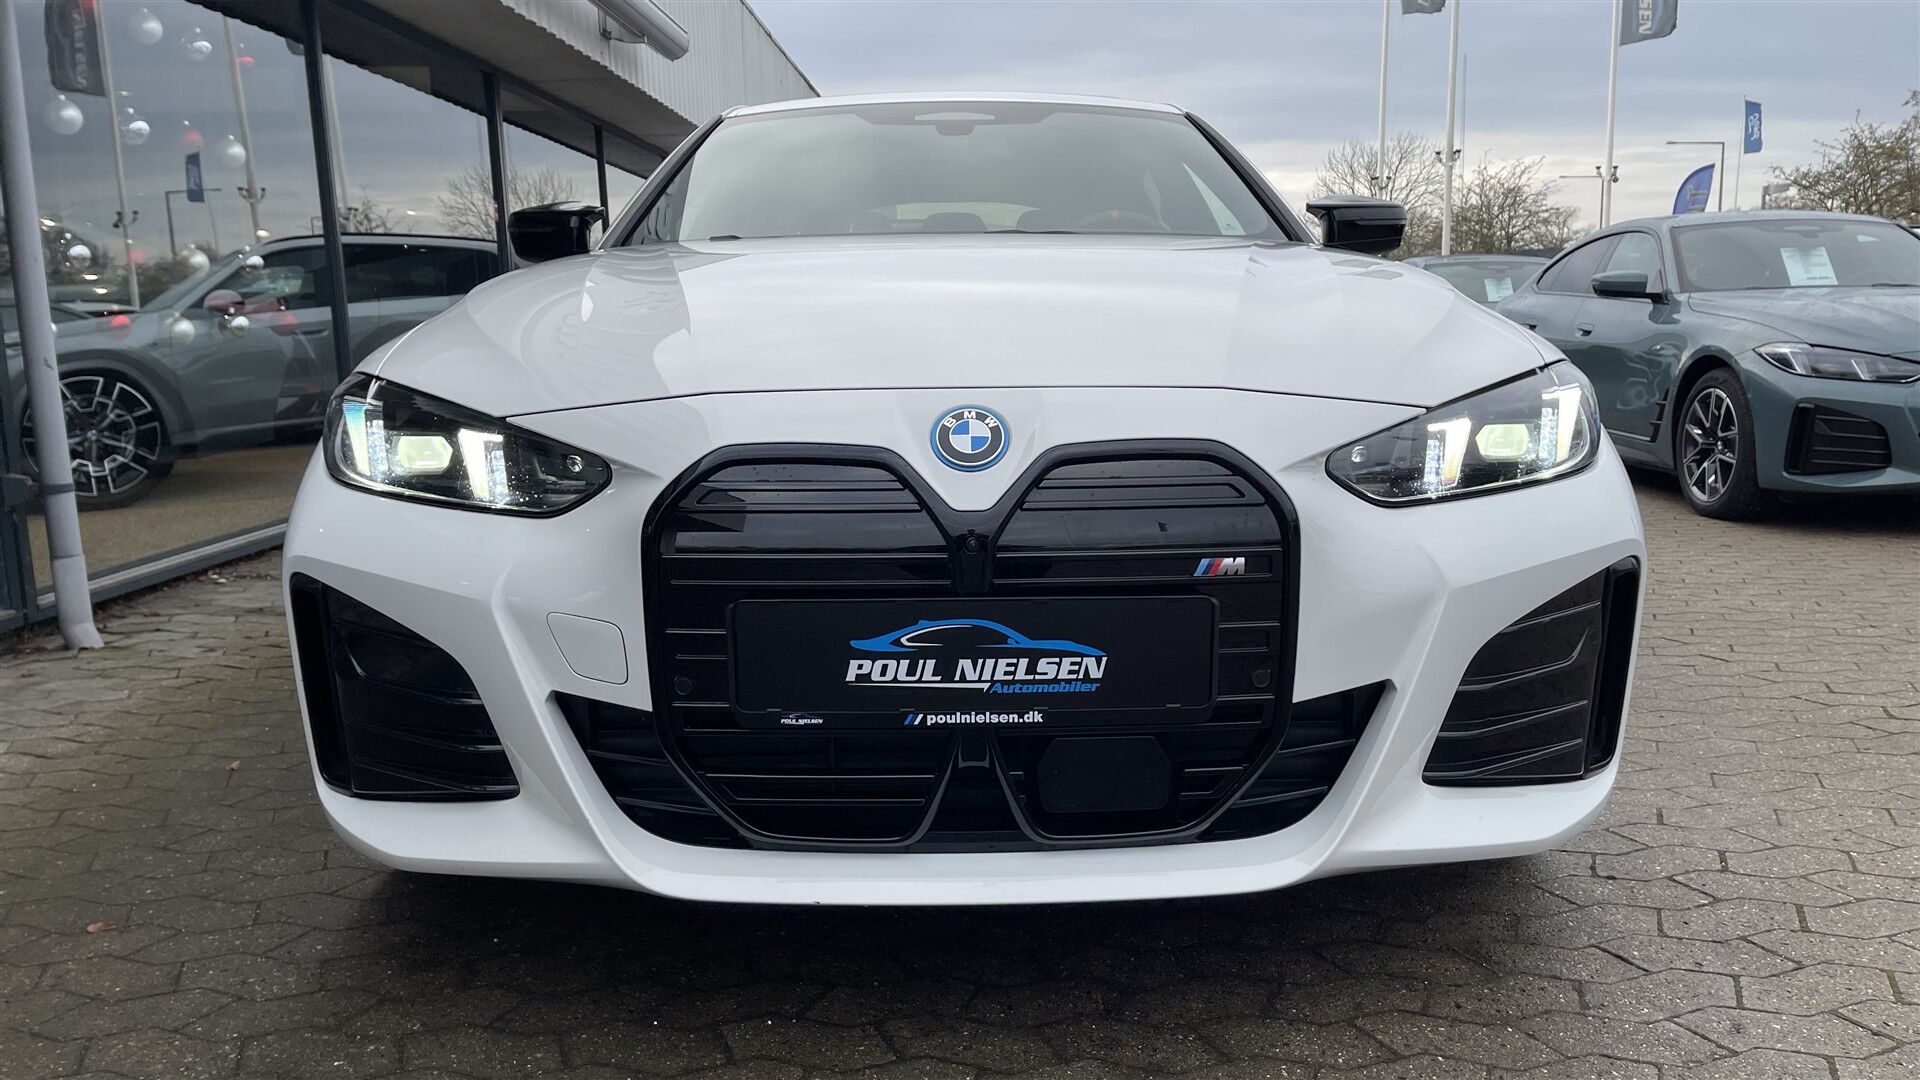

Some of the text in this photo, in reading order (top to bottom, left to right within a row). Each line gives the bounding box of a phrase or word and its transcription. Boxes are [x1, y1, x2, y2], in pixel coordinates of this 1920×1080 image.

[943, 411, 998, 428] BMW
[1216, 557, 1245, 575] M
[845, 657, 1108, 681] POUL NIELSEN
[990, 682, 1100, 694] Automobiler
[927, 711, 1043, 726] poulnielsen.dk
